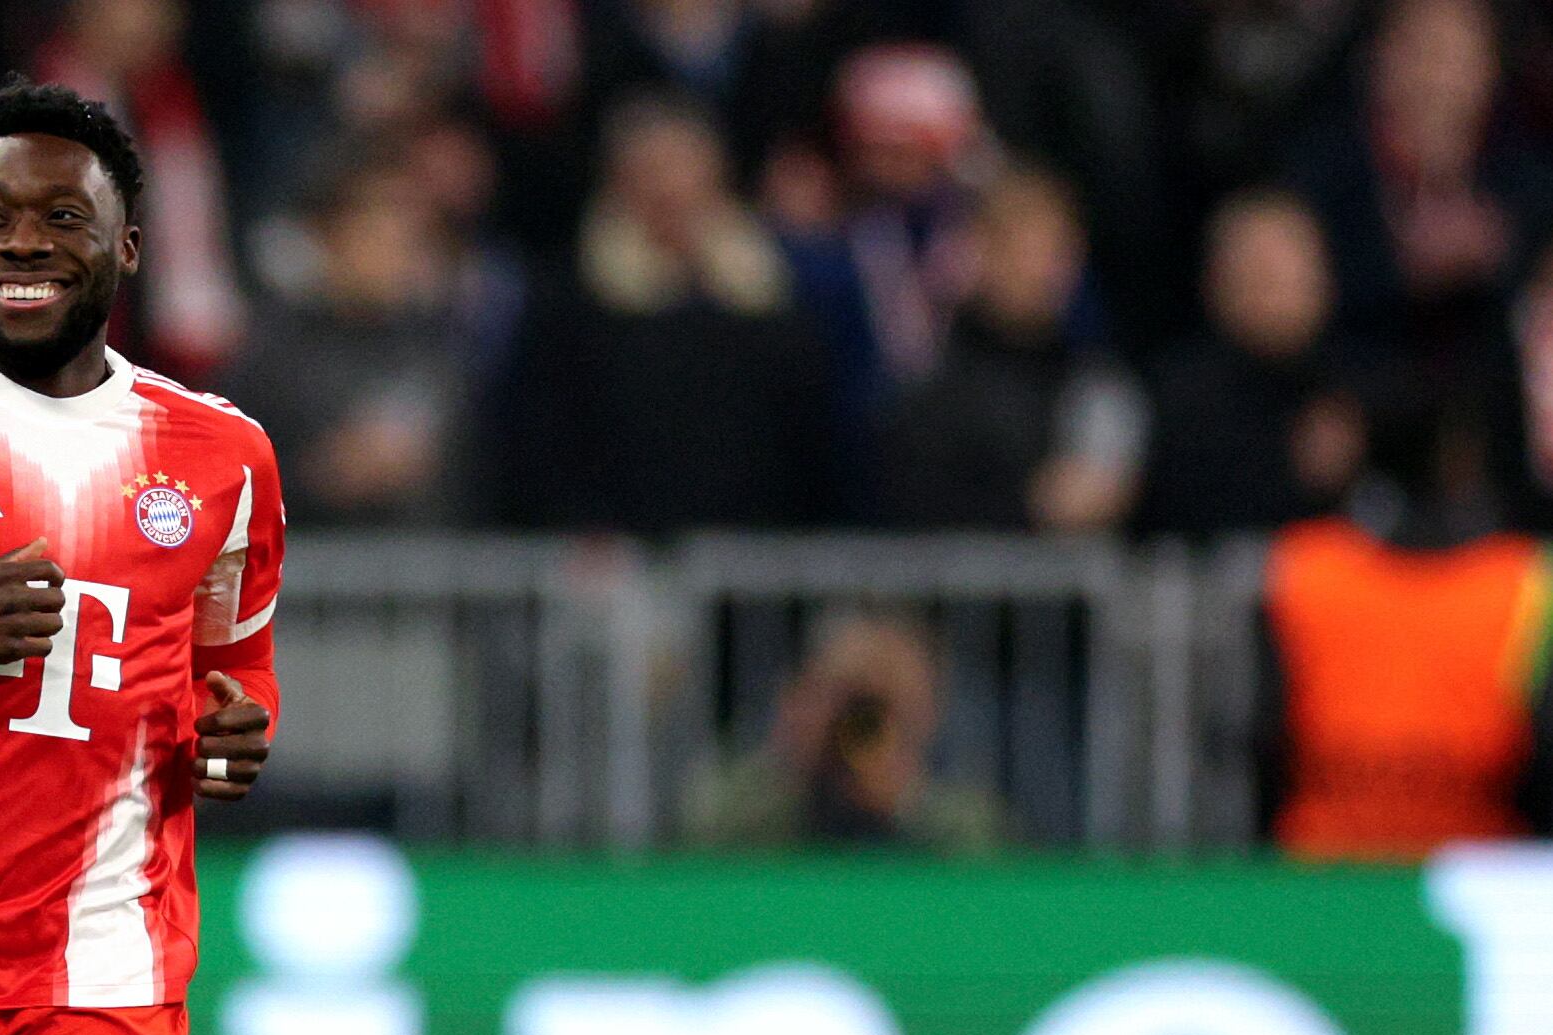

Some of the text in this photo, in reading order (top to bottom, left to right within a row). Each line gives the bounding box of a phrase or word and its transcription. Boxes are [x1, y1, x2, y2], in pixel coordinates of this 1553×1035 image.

[140, 491, 188, 517] FC BAYERN
[141, 518, 187, 543] MÜNCHEN
